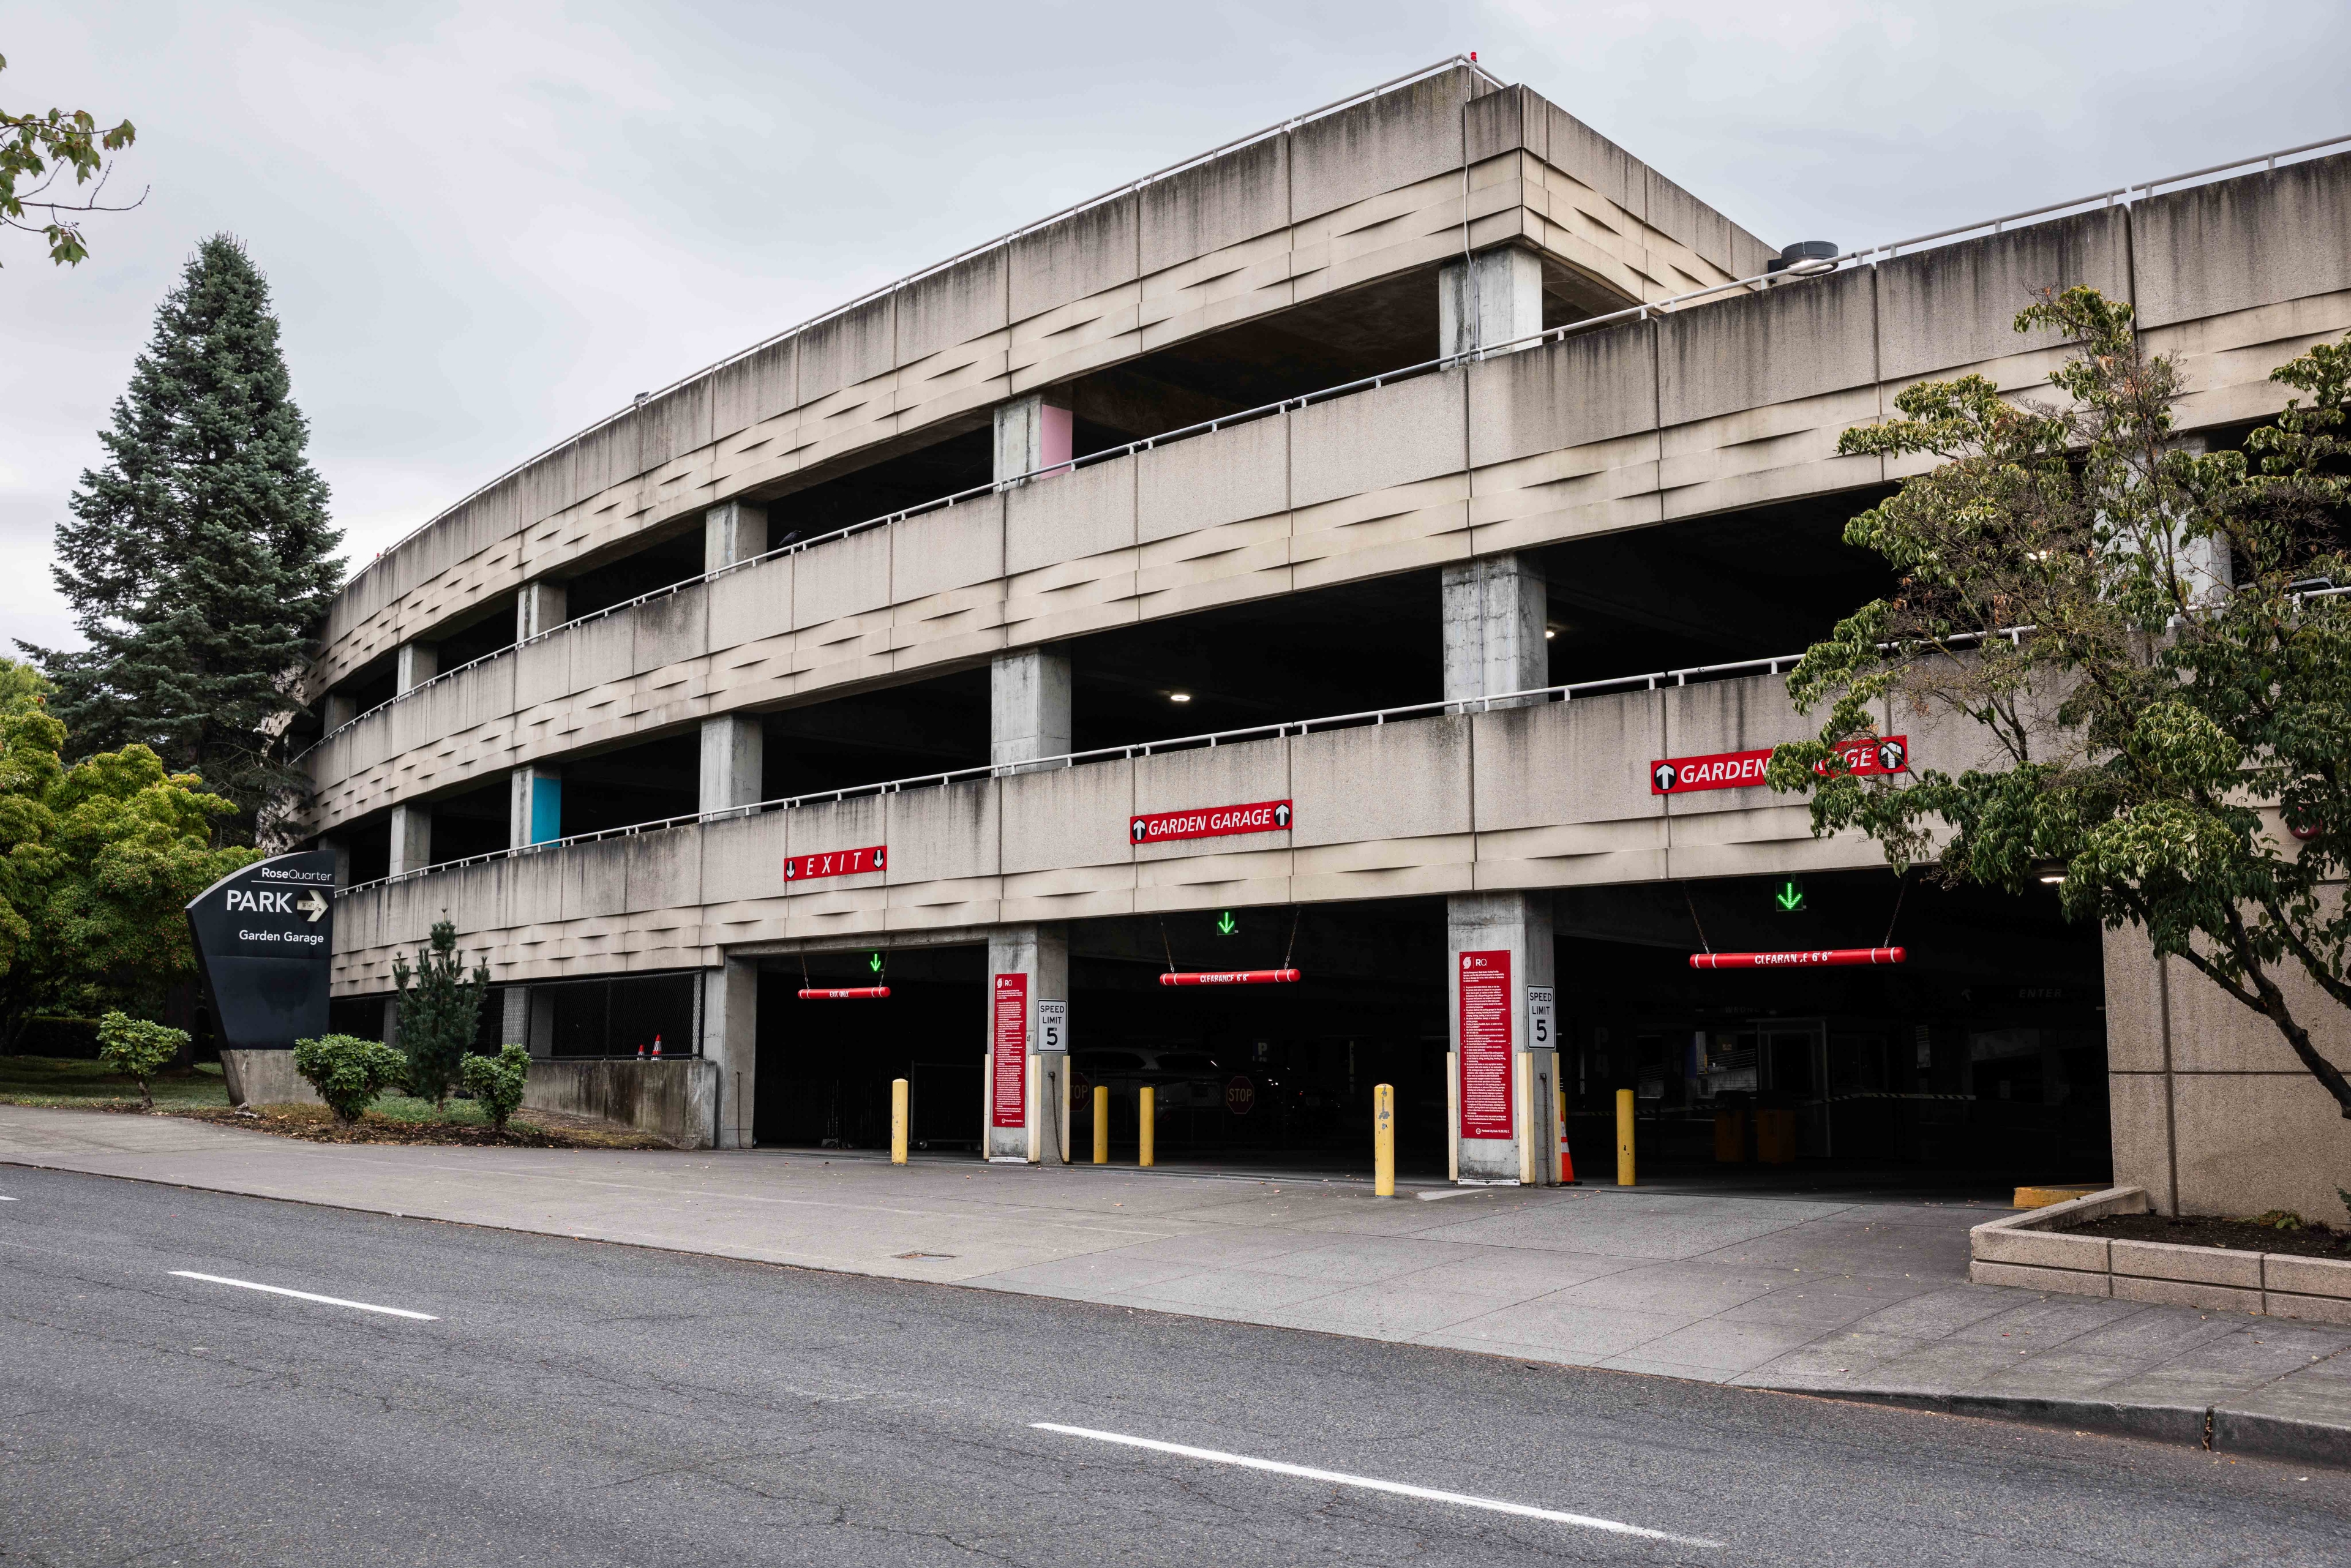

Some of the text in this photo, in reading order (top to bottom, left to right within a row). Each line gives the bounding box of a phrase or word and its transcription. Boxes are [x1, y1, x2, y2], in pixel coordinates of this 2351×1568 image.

[1679, 757, 1769, 784] GARDEN
[1148, 808, 1272, 836] GARDEN GARAGE
[806, 852, 862, 876] EXIT
[261, 867, 332, 882] RoseQuarter
[226, 889, 293, 913] PARK
[238, 929, 324, 945] Garden Garage
[1755, 953, 1808, 964] CLEARANE
[1529, 991, 1553, 1002] SPEED
[1531, 1005, 1551, 1016] LIMIT
[1046, 1027, 1058, 1046] 5
[1535, 1019, 1548, 1042] 5
[1228, 1088, 1253, 1102] STOP
